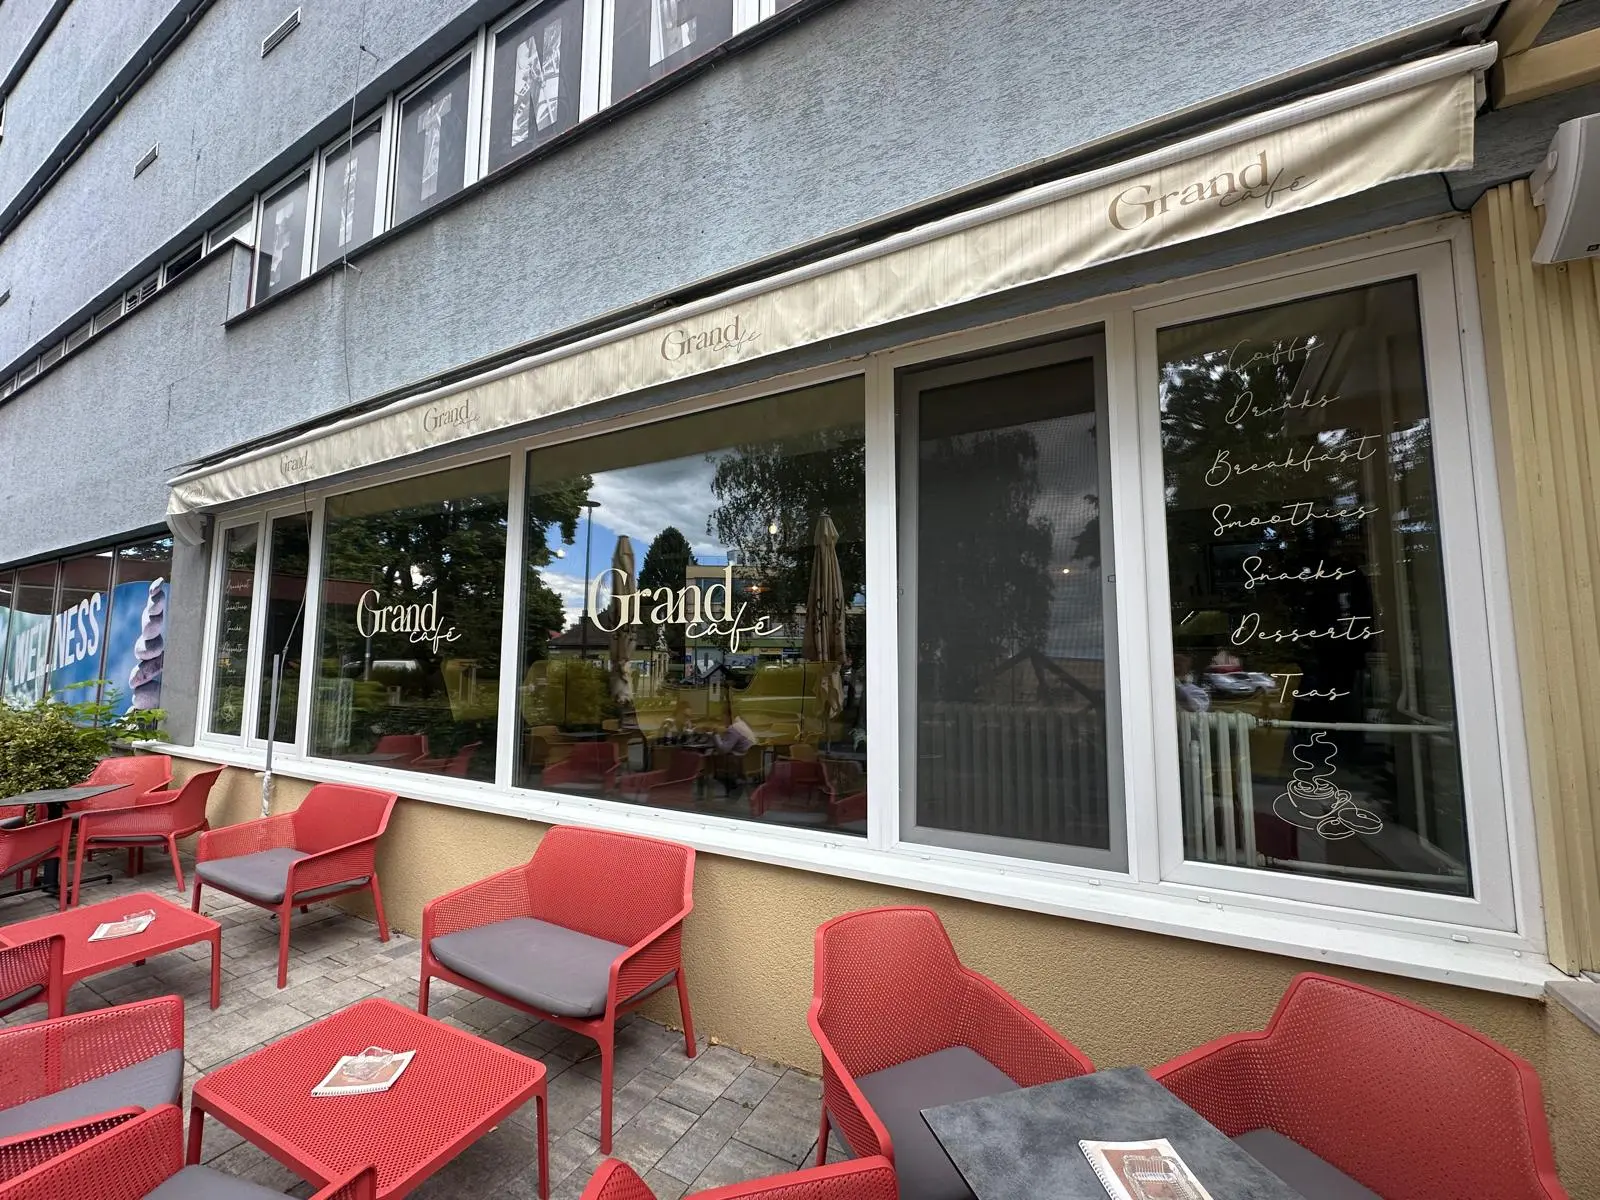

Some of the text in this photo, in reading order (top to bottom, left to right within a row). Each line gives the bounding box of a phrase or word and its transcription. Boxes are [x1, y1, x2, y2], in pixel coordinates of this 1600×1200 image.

[1108, 149, 1270, 231] Grand
[1219, 167, 1318, 209] café
[660, 314, 740, 361] Grand
[423, 398, 469, 433] Grand
[1225, 389, 1341, 426] Drinks
[1205, 434, 1382, 487] Breakfast
[1212, 502, 1379, 537] Smoothies
[1242, 556, 1357, 589] Snacks
[356, 588, 439, 639] Grand
[587, 564, 736, 633] Grand
[409, 616, 462, 656] café
[685, 601, 784, 654] café
[1231, 612, 1385, 646] Desserts
[1270, 672, 1351, 704] Teas
